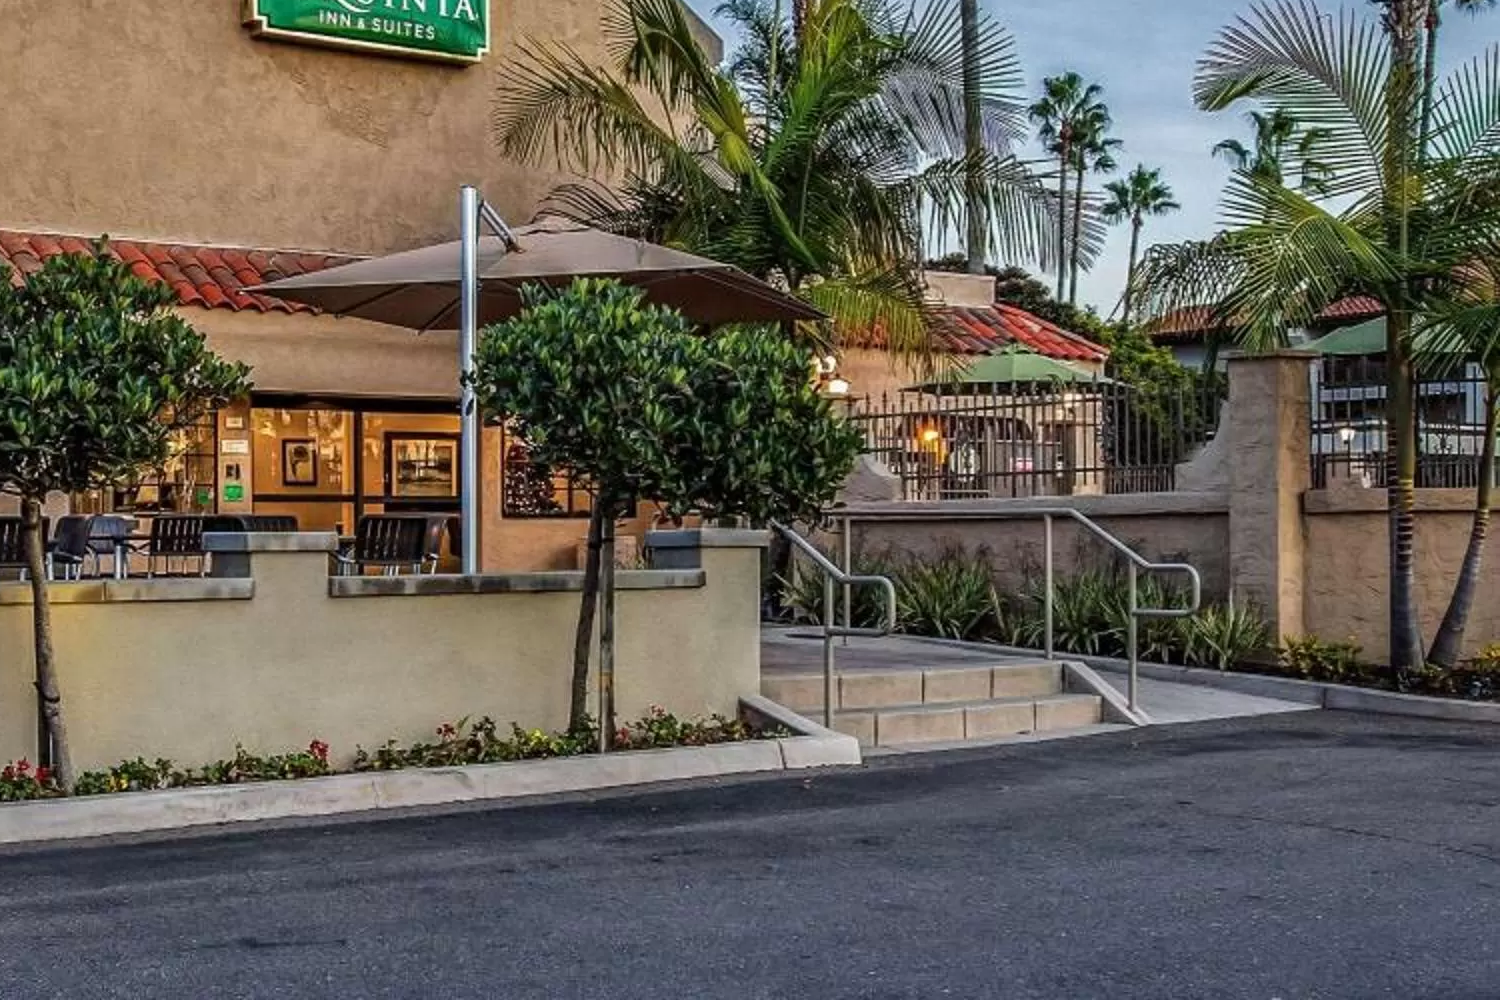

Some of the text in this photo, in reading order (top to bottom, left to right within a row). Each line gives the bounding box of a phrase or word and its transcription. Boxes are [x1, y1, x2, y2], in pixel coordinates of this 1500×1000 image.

[319, 10, 435, 40] INN & SUITES
